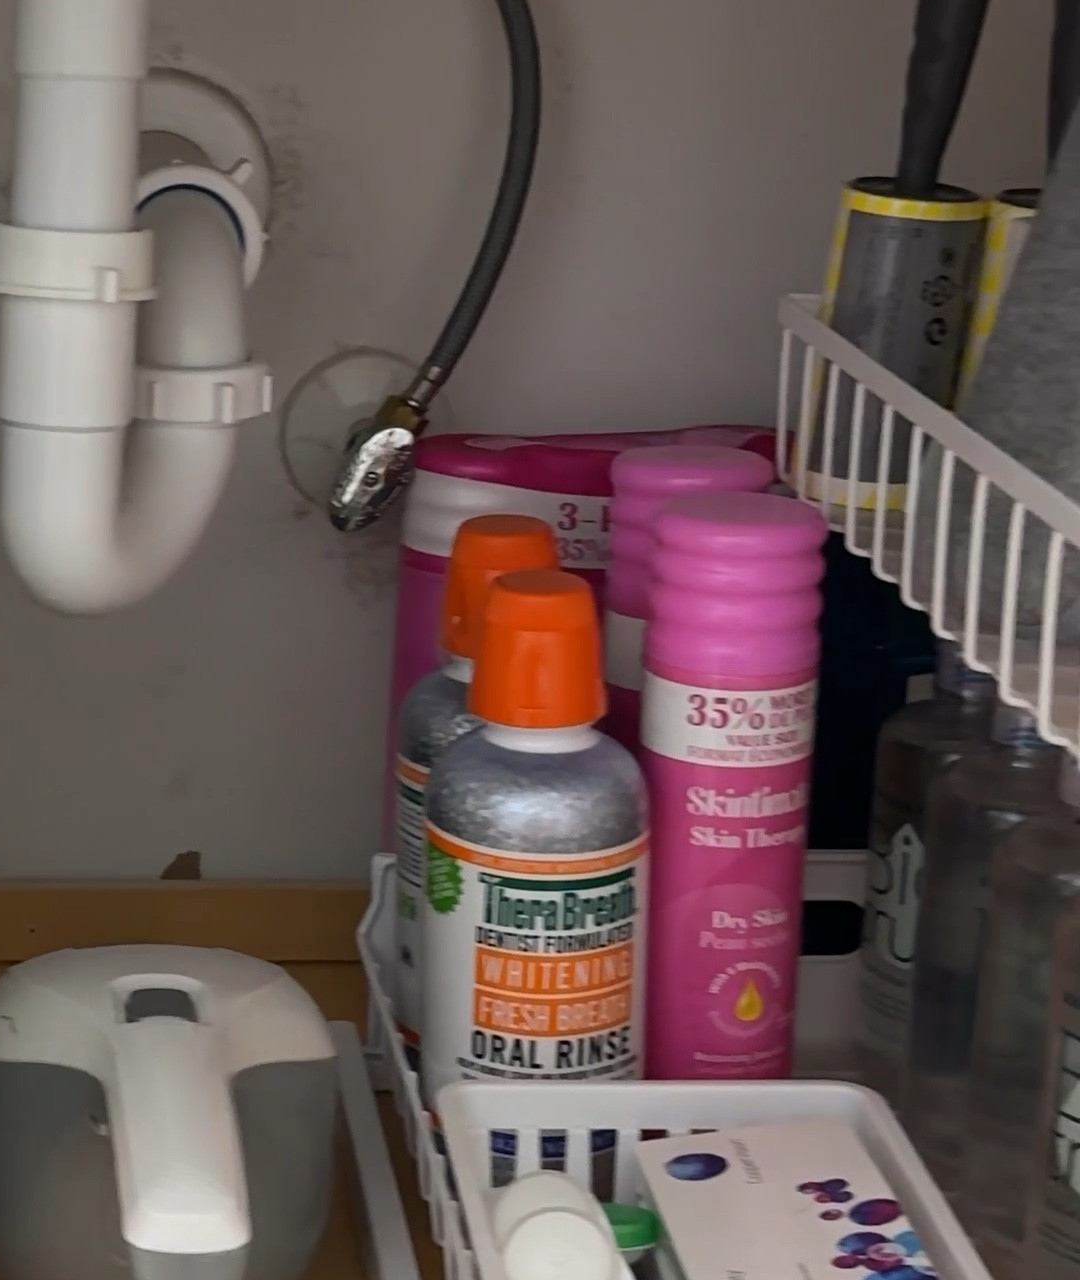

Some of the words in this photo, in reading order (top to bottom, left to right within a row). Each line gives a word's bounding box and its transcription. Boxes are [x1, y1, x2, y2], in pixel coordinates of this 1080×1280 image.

[686, 693, 765, 730] 35%
[480, 950, 631, 991] WHITENING
[478, 995, 551, 1032] FRESH
[556, 993, 629, 1032] BREATH
[471, 1030, 543, 1069] ORAL
[555, 1025, 631, 1069] RINSE
